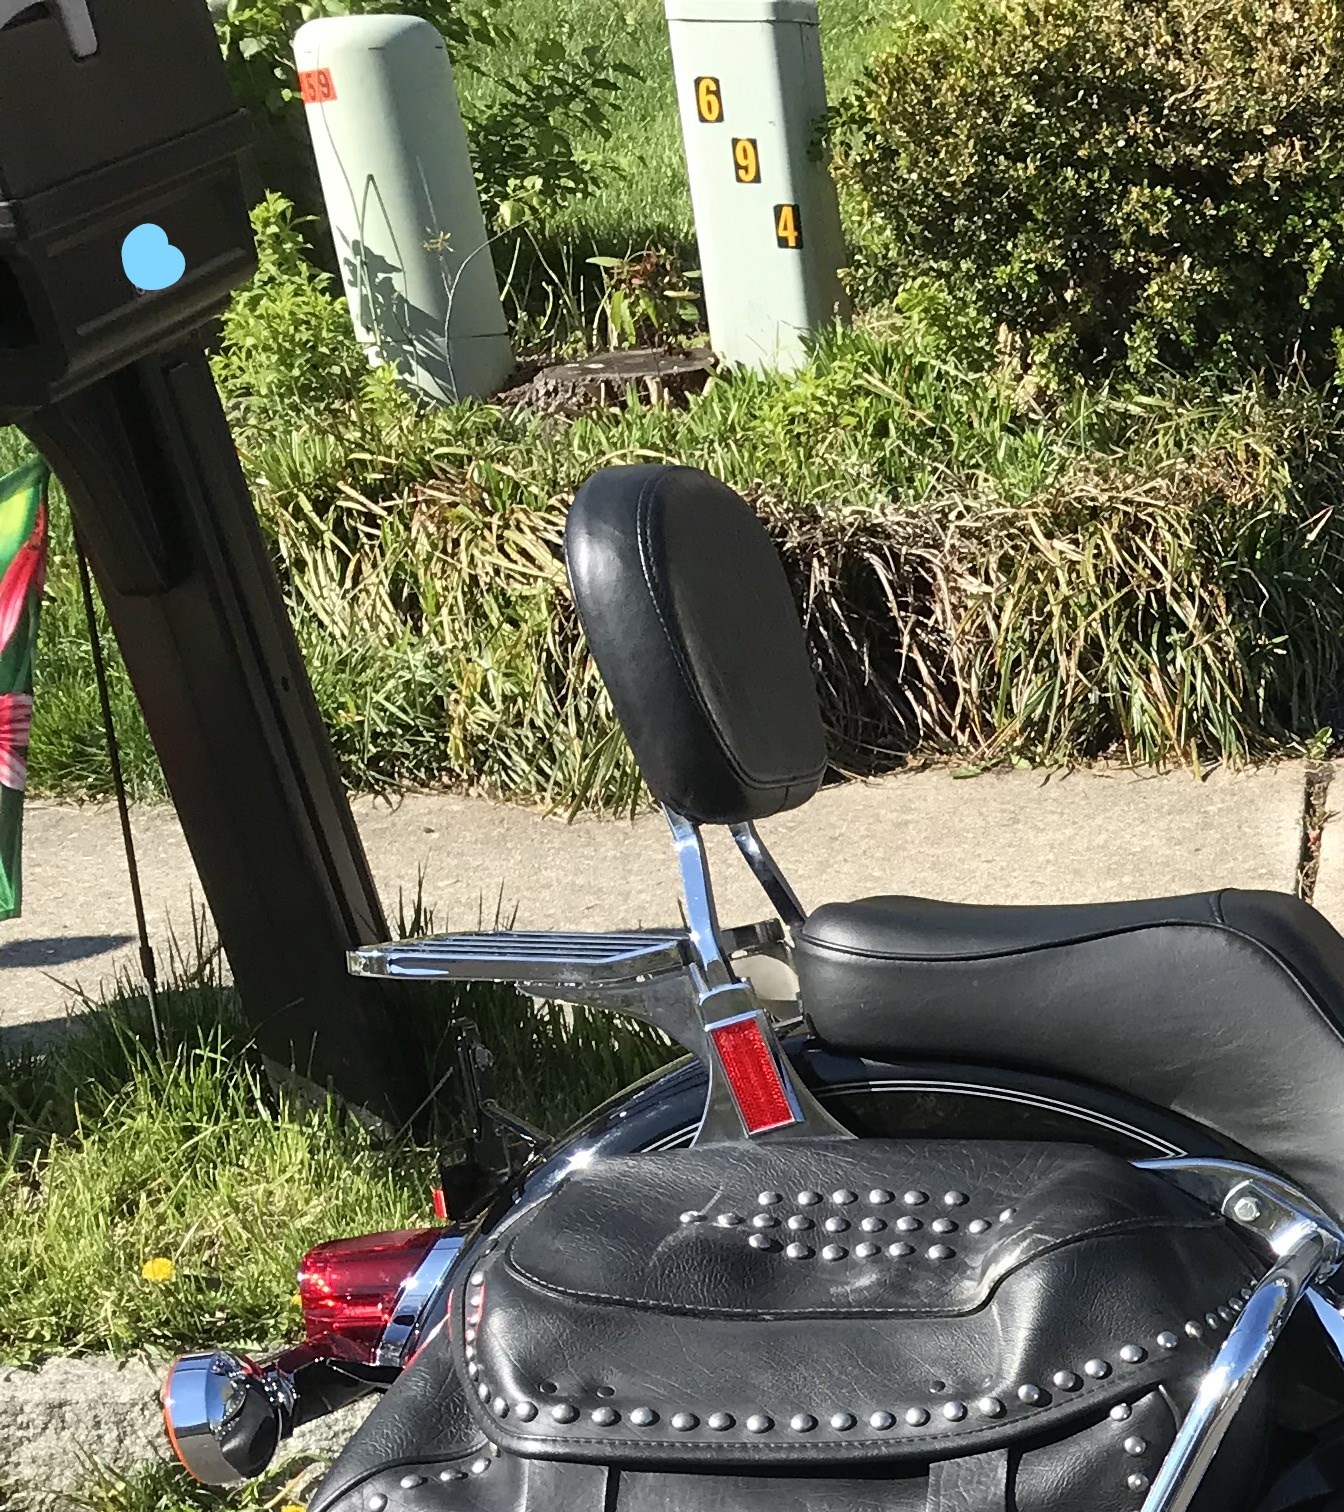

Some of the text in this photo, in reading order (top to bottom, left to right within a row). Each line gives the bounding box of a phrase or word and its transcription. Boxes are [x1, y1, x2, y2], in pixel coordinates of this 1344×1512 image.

[698, 78, 798, 247] 6 9 4
